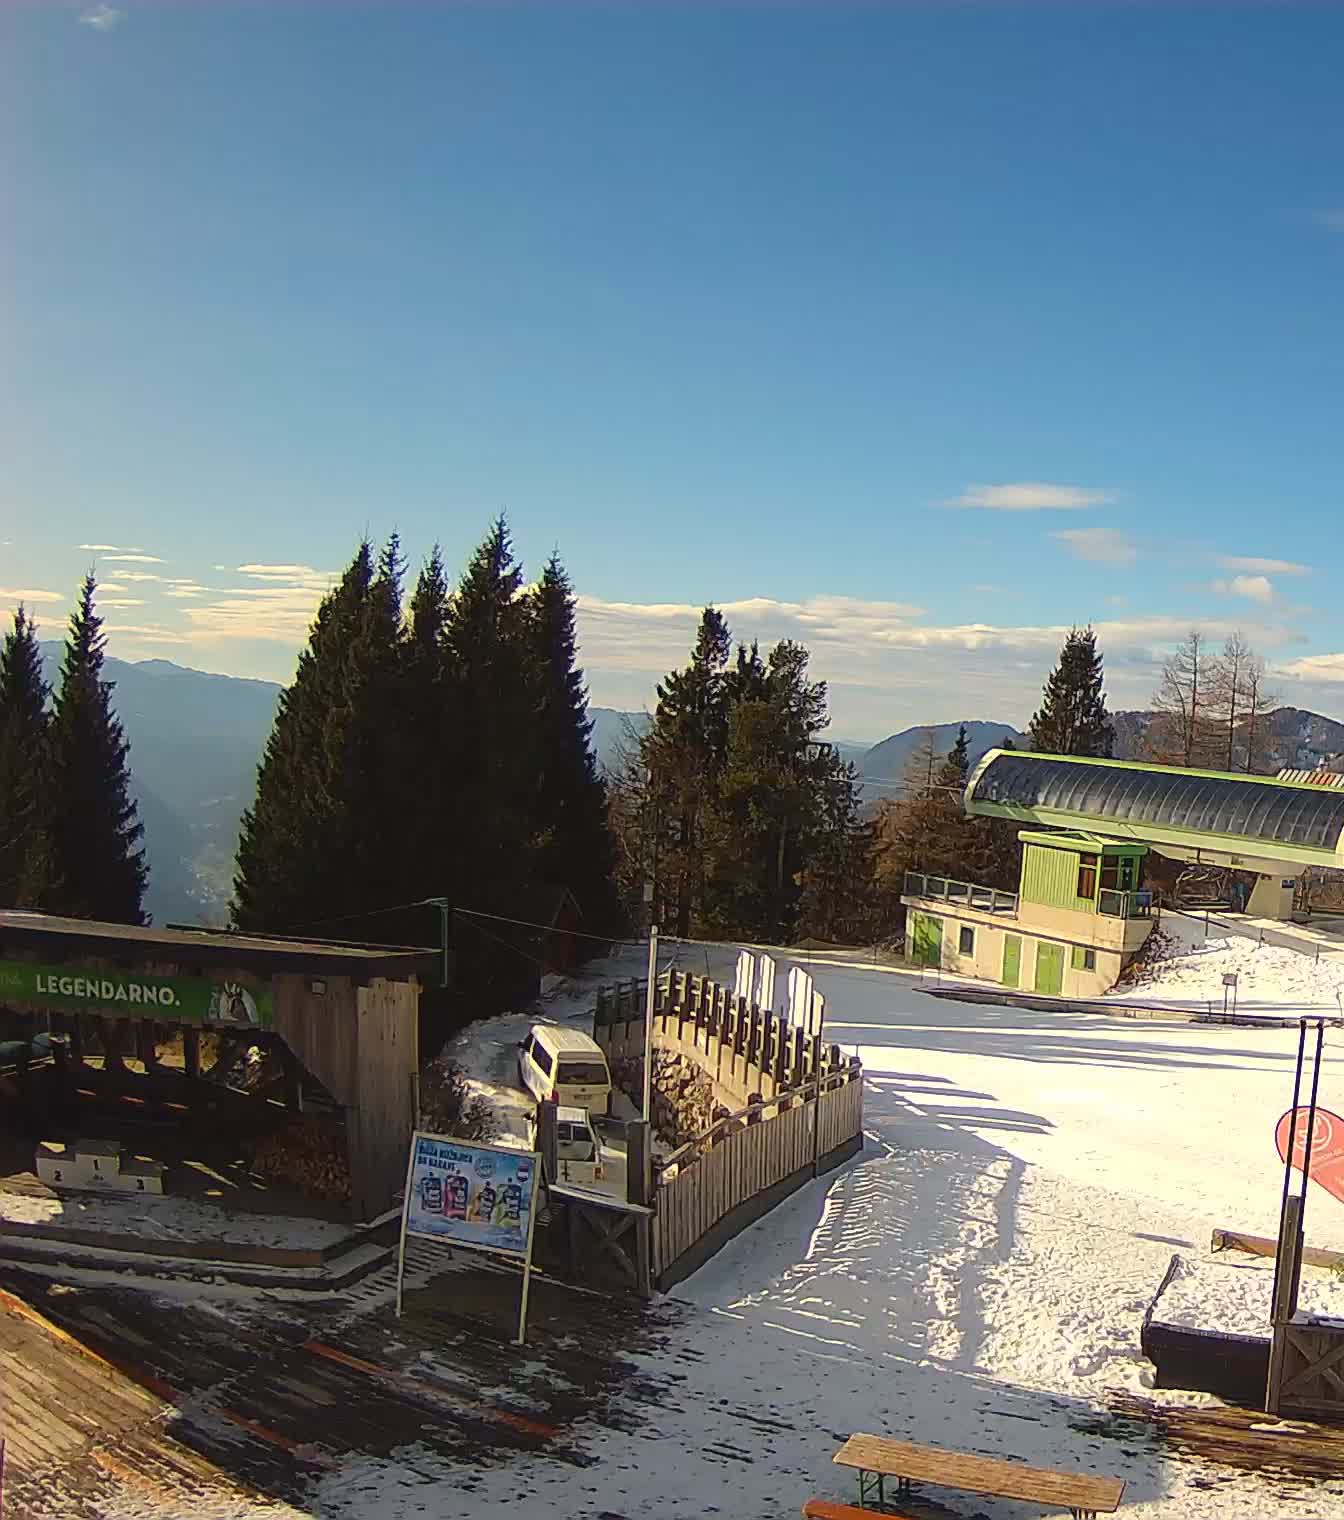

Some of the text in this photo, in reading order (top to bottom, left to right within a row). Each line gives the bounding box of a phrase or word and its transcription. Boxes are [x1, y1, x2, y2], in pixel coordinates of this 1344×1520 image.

[35, 974, 181, 1007] LEGENDARNO.
[93, 1159, 100, 1171] 1
[54, 1169, 62, 1182] 2
[136, 1178, 145, 1191] 3
